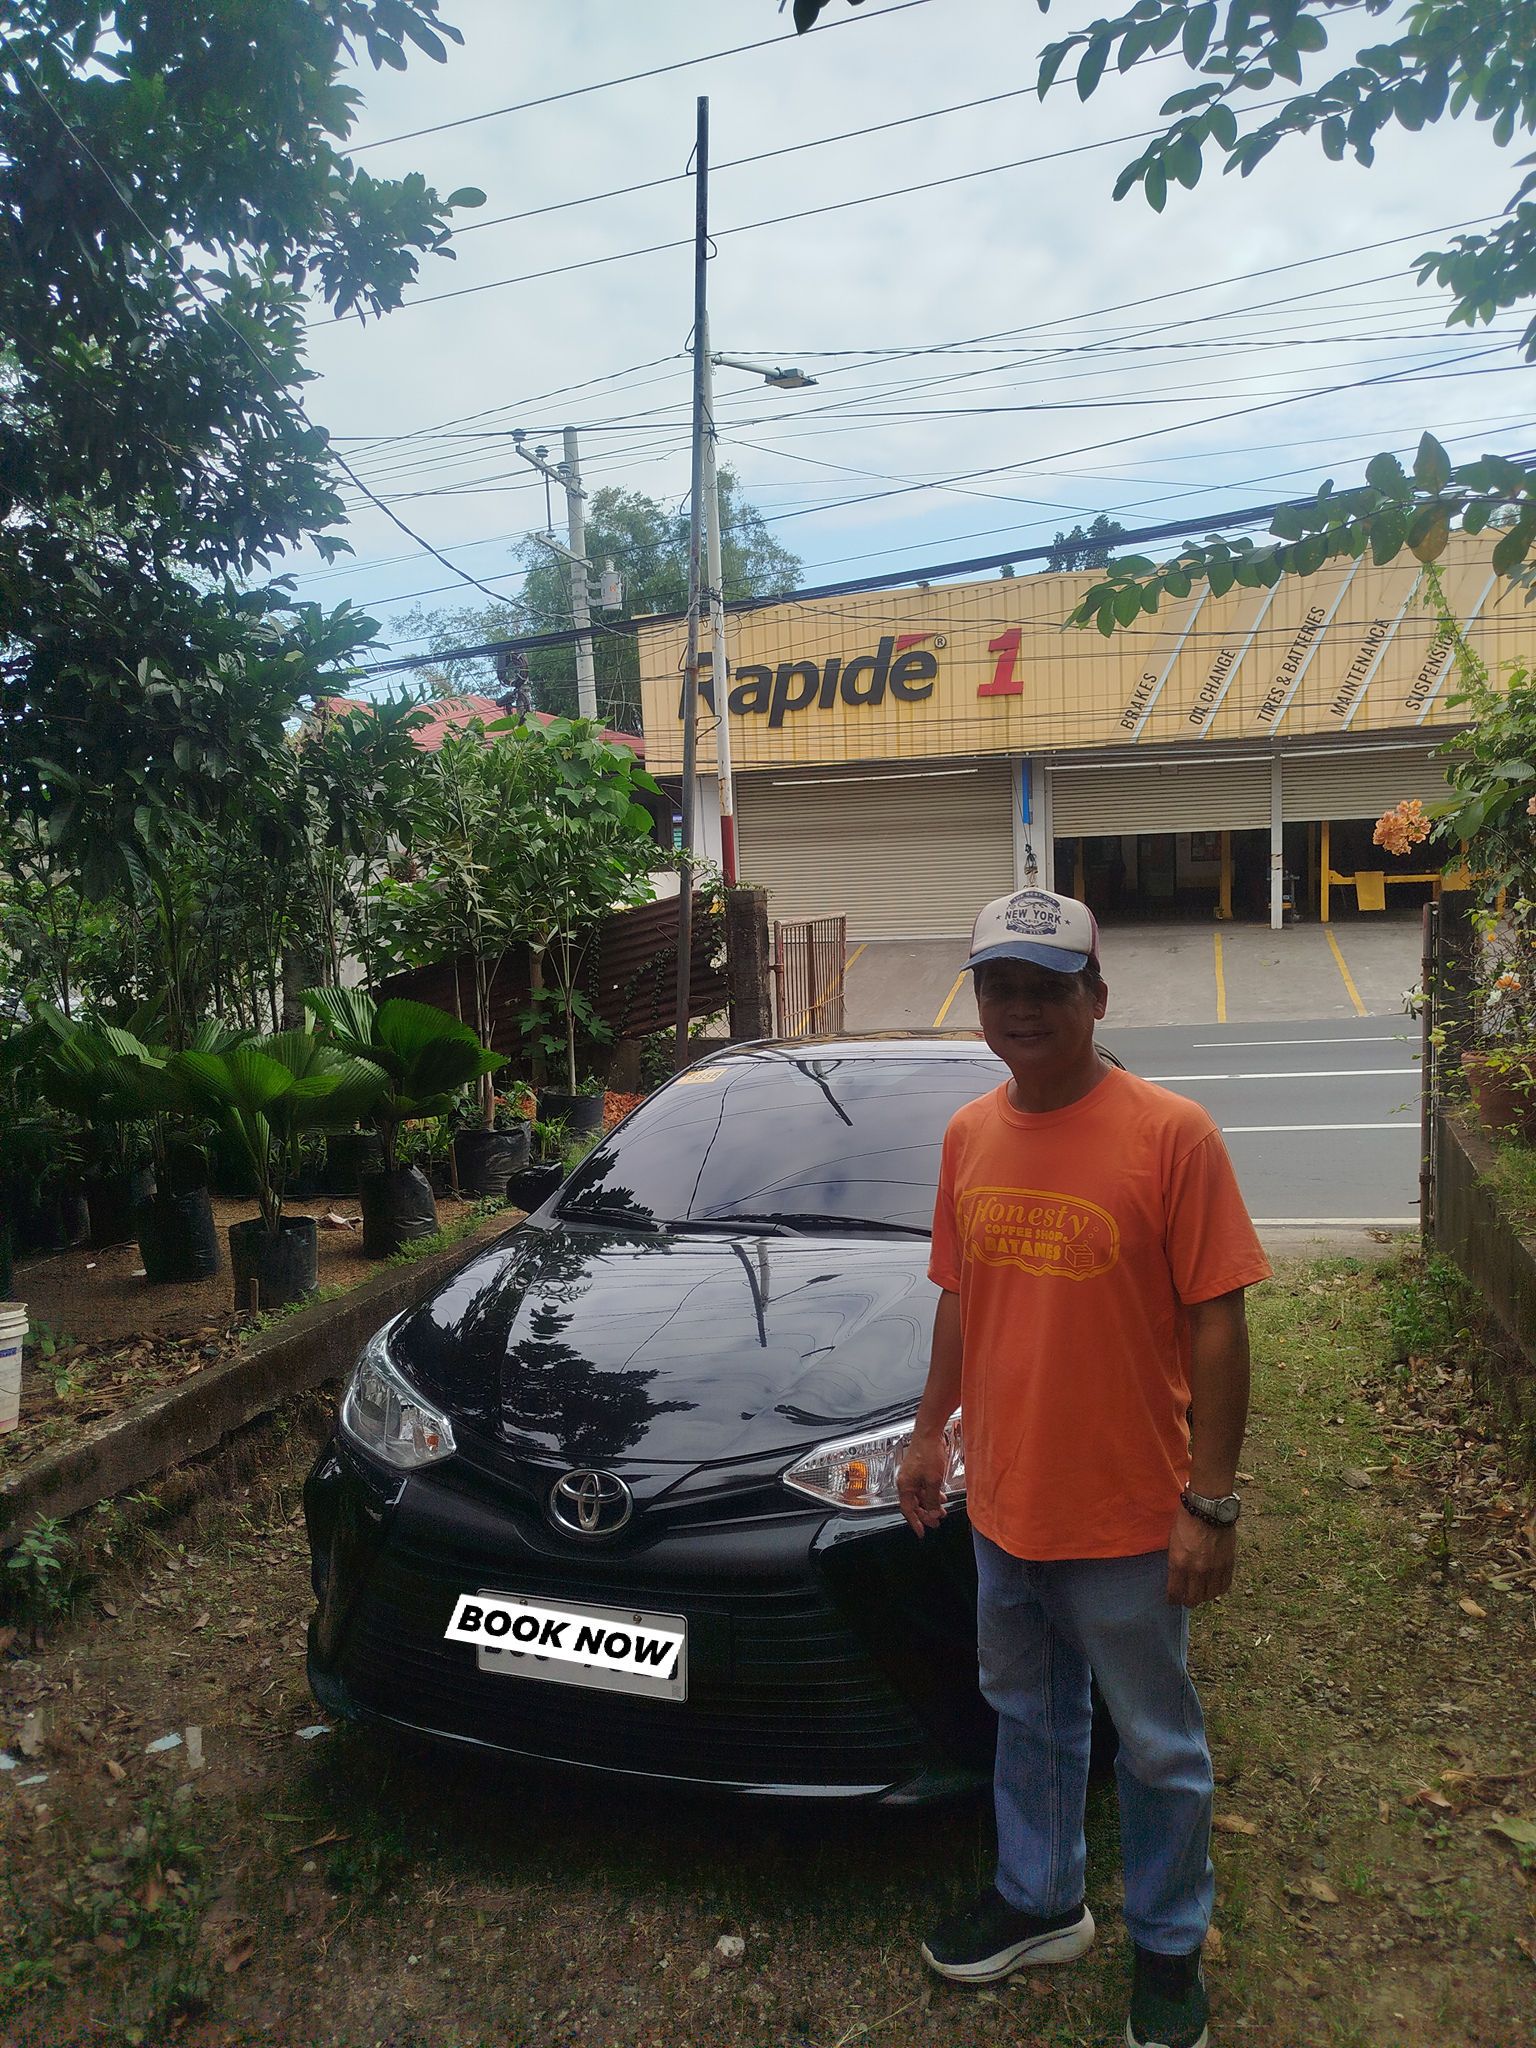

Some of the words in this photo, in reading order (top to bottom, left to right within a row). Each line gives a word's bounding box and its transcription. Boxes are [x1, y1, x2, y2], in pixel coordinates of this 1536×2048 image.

[977, 627, 1025, 697] 1
[1281, 606, 1326, 674] BATTERIES
[1188, 705, 1209, 725] OIL
[1199, 648, 1236, 703] CHANGE
[1276, 675, 1292, 686] &
[1330, 618, 1390, 717] MAINTENANCE
[1405, 630, 1454, 711] SUSPENSIO
[1120, 672, 1157, 730] BRAKES
[1257, 687, 1285, 722] TIRES
[1005, 909, 1028, 920] NEW
[1033, 909, 1061, 925] YORK
[971, 1196, 1089, 1243] Honesty
[984, 1223, 1032, 1238] COFFEE
[1035, 1229, 1063, 1241] SHOP
[984, 1236, 1061, 1261] BATANES
